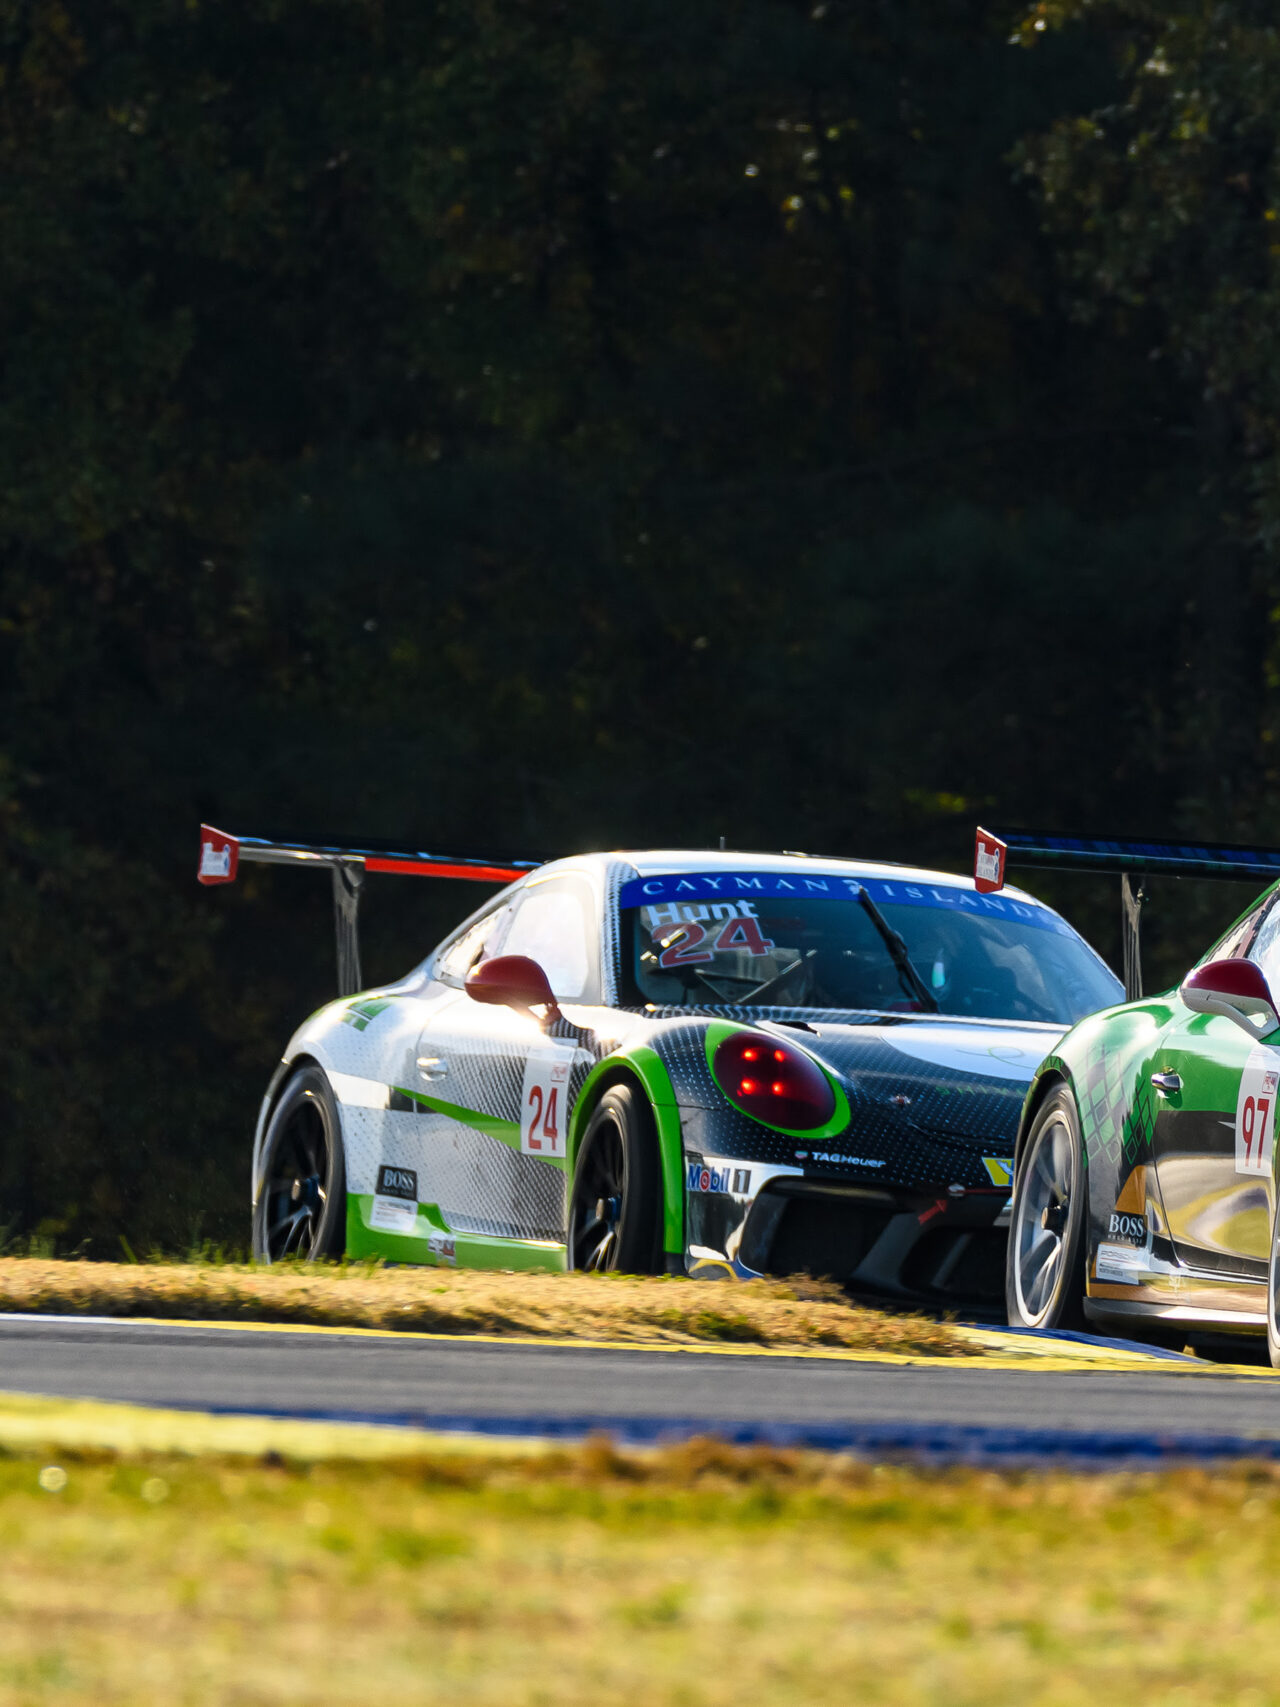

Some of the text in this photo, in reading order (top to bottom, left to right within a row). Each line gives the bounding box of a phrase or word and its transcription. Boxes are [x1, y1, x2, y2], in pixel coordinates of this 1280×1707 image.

[642, 877, 1047, 928] CAYMAN ISLAND
[647, 900, 759, 926] Hunt
[651, 917, 775, 968] 24
[528, 1085, 558, 1151] 24
[1242, 1095, 1270, 1169] 97
[383, 1168, 415, 1191] BOSS
[686, 1162, 731, 1193] Mobil
[1108, 1214, 1145, 1238] BOSS
